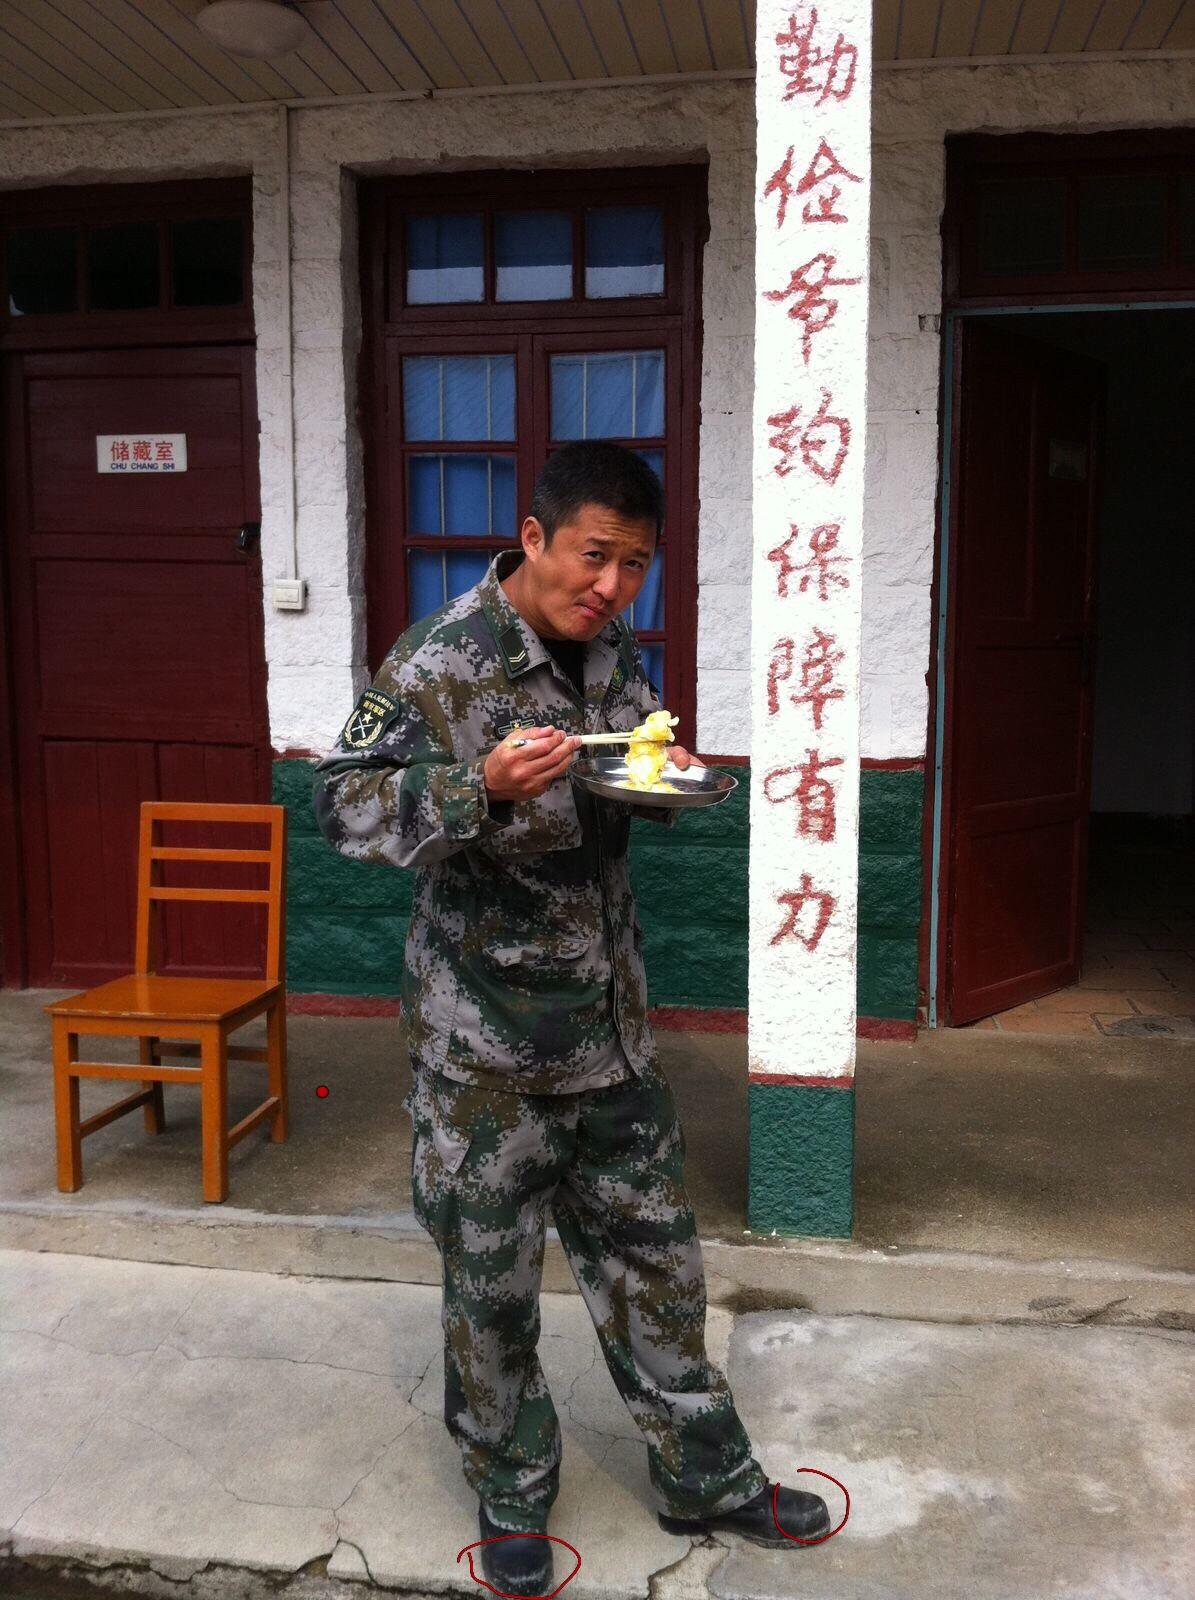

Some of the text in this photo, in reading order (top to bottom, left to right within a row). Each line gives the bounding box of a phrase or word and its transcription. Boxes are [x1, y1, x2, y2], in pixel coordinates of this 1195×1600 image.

[111, 440, 174, 461] 储藏室
[110, 462, 175, 470] CHU CHANG SHI
